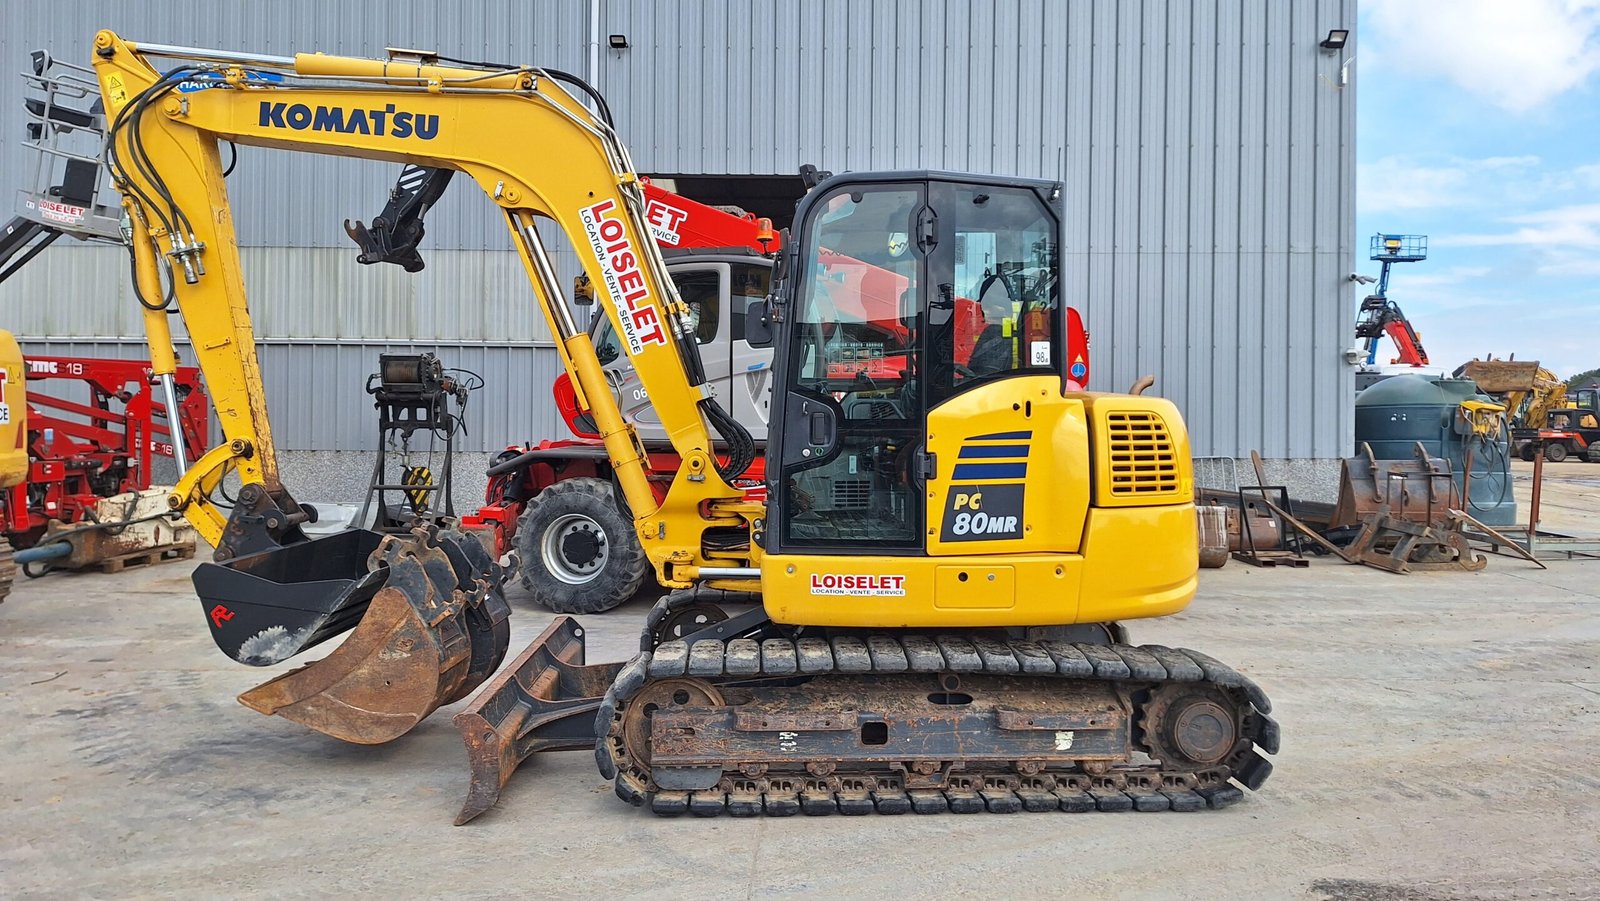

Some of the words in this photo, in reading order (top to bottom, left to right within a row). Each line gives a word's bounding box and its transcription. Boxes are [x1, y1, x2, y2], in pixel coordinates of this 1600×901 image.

[259, 102, 439, 140] KOMATSU
[40, 201, 84, 216] LOISELET
[581, 209, 605, 261] LOCATION
[604, 267, 621, 303] VENTE
[619, 309, 641, 353] SERVICE
[591, 201, 664, 344] LOISELET
[953, 493, 982, 510] PC
[952, 512, 1017, 535] 80MR
[812, 575, 904, 589] LOISELET
